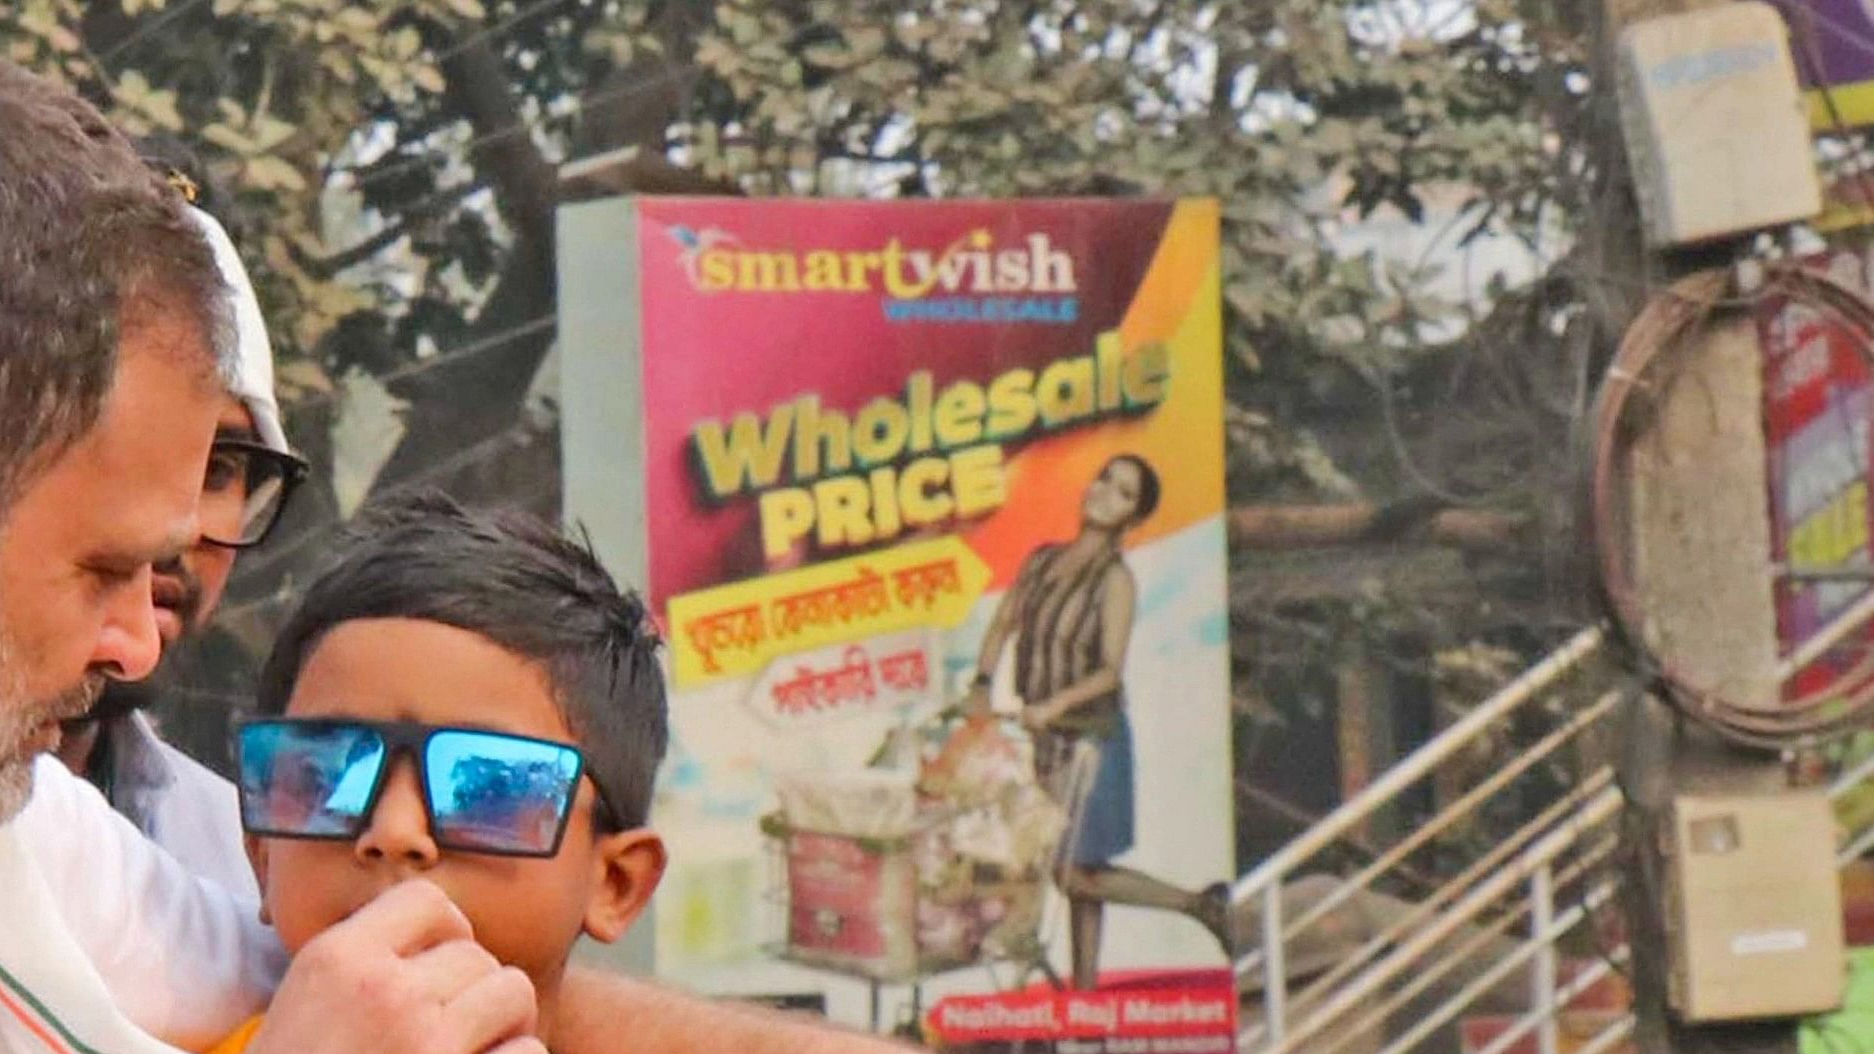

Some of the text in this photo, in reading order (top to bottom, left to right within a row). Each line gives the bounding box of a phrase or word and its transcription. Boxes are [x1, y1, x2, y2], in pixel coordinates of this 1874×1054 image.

[700, 230, 1078, 299] smartwish
[694, 328, 1171, 496] Wholesale
[760, 445, 1008, 562] PRICE
